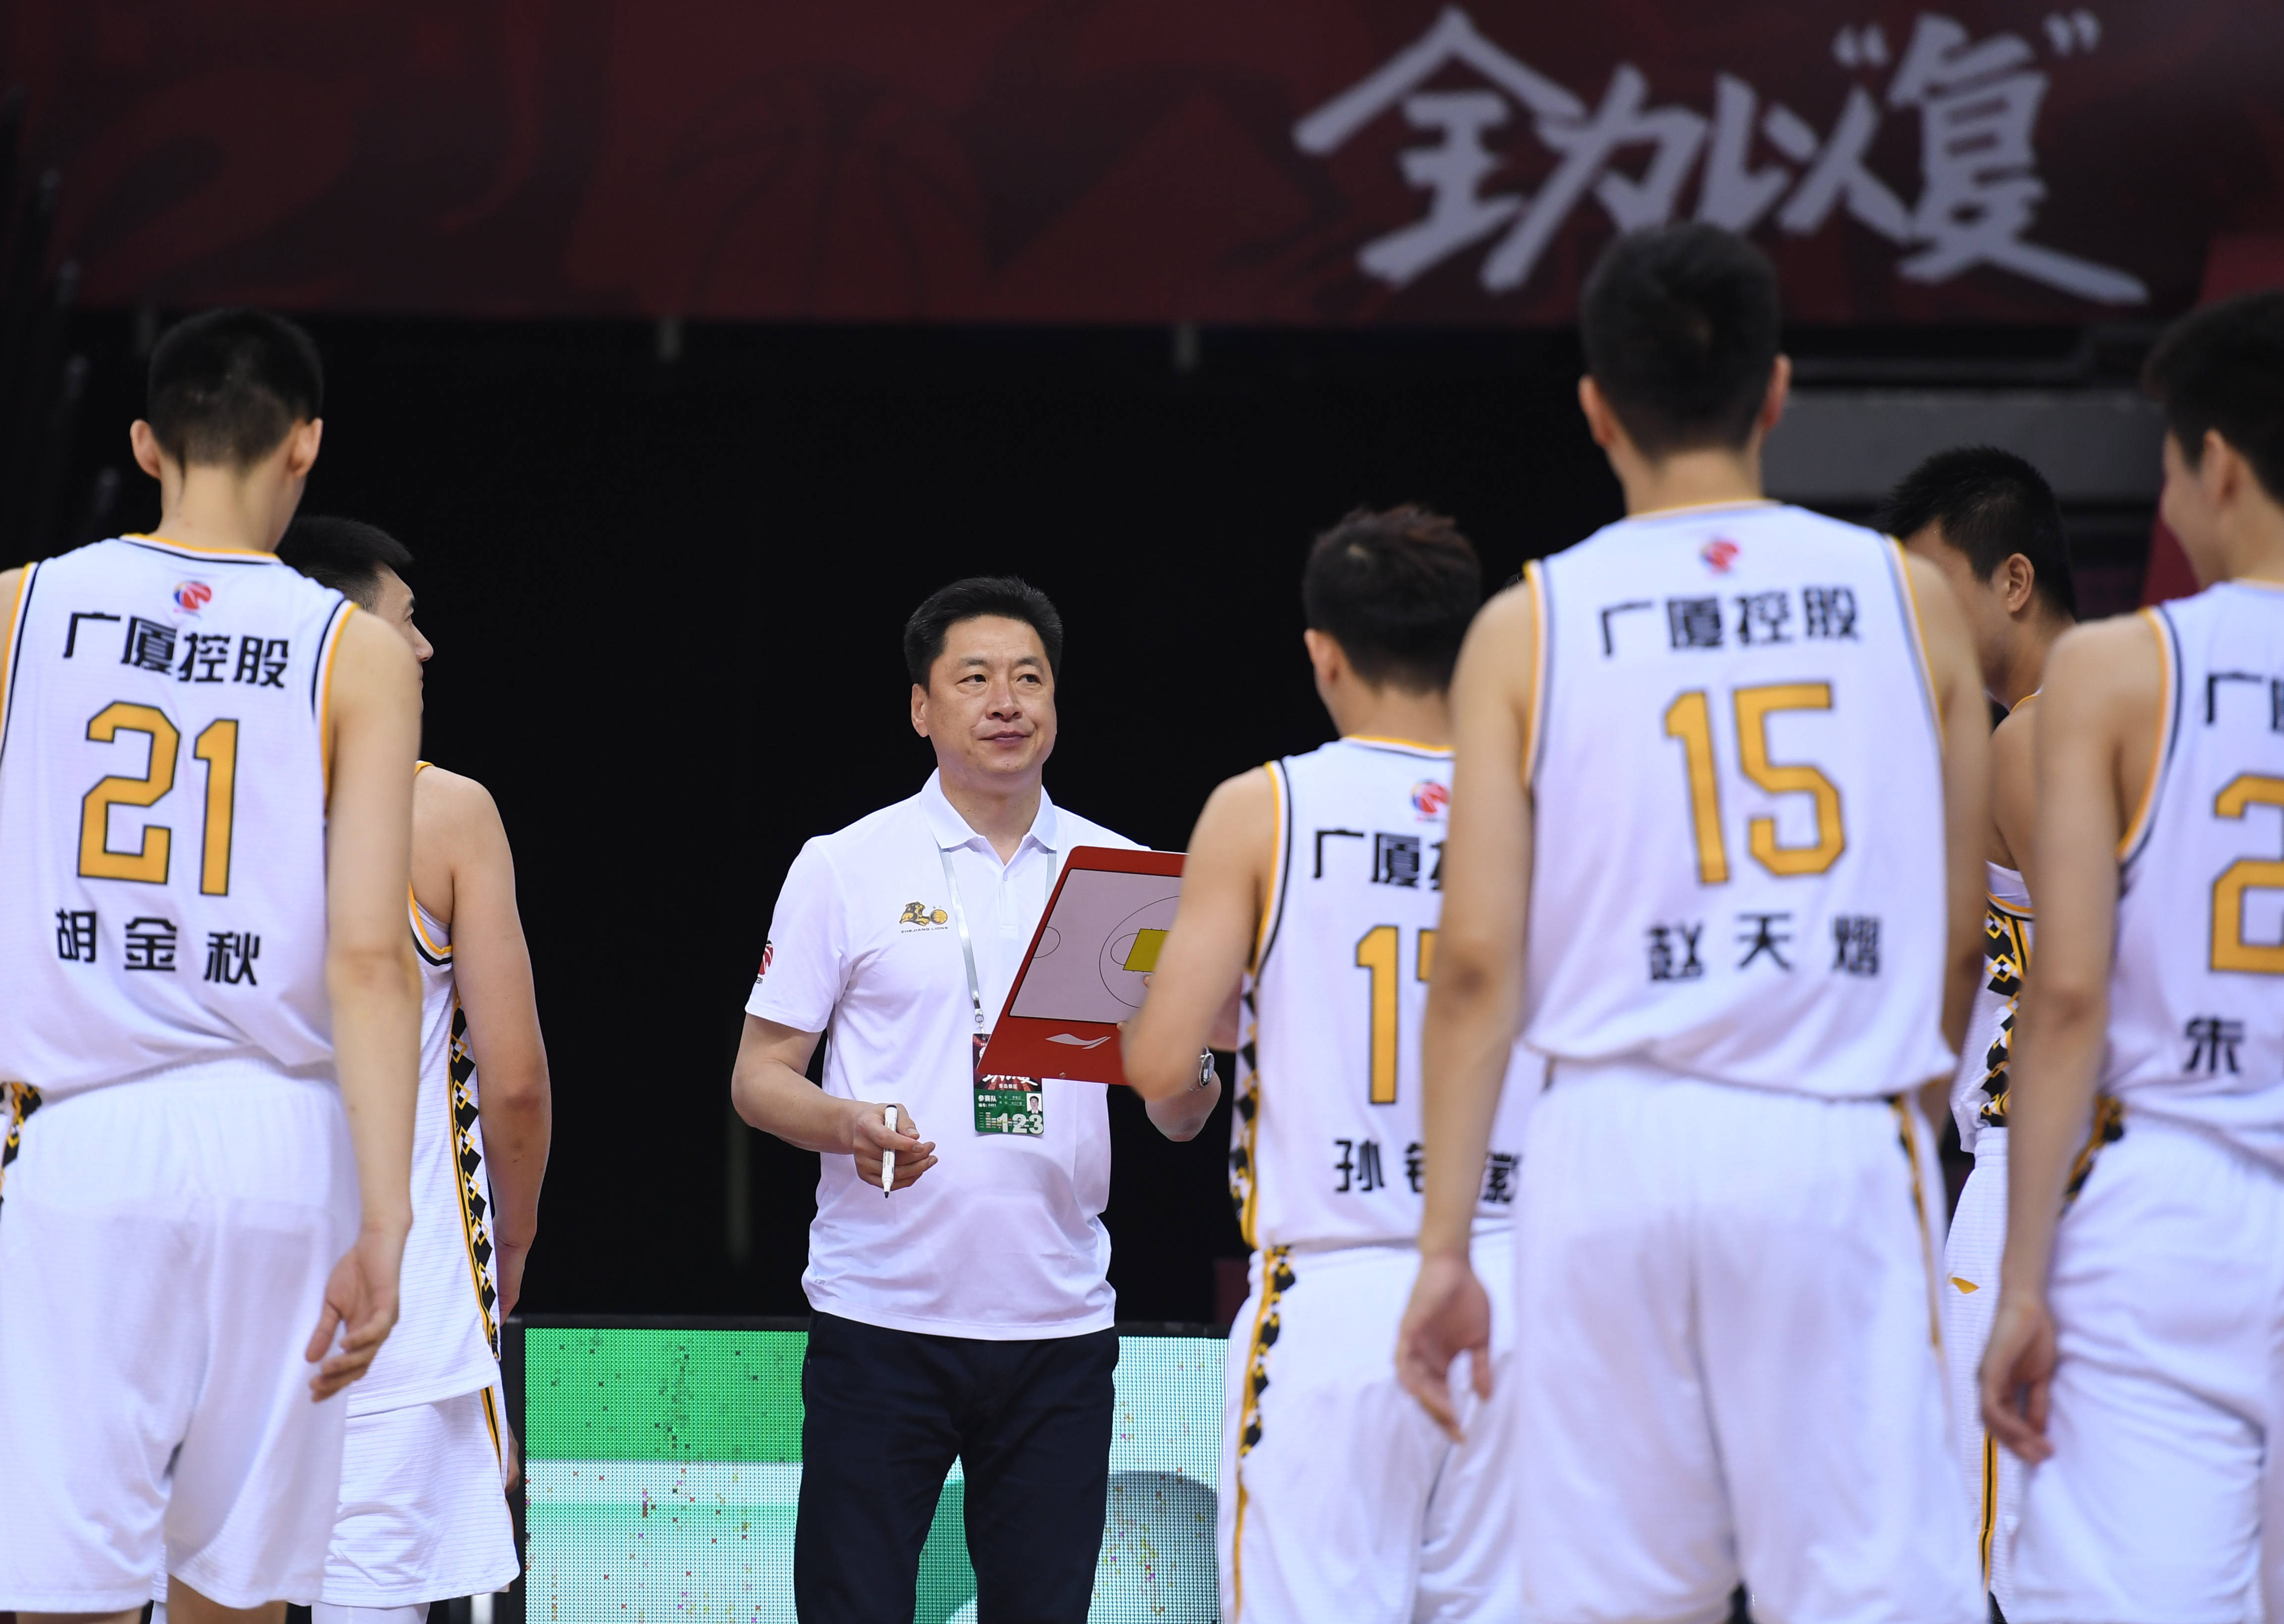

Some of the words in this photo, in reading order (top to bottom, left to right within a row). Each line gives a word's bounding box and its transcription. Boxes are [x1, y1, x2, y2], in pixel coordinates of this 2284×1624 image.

[63, 612, 290, 689] 广厦控股
[1599, 585, 1860, 658] 广厦控股
[2206, 671, 2284, 731] 广
[77, 700, 239, 897] 21
[1664, 681, 1846, 884] 15
[1313, 830, 1445, 892] 广厦
[55, 908, 260, 985] 胡金秋
[1648, 912, 1882, 982] 赵天熠
